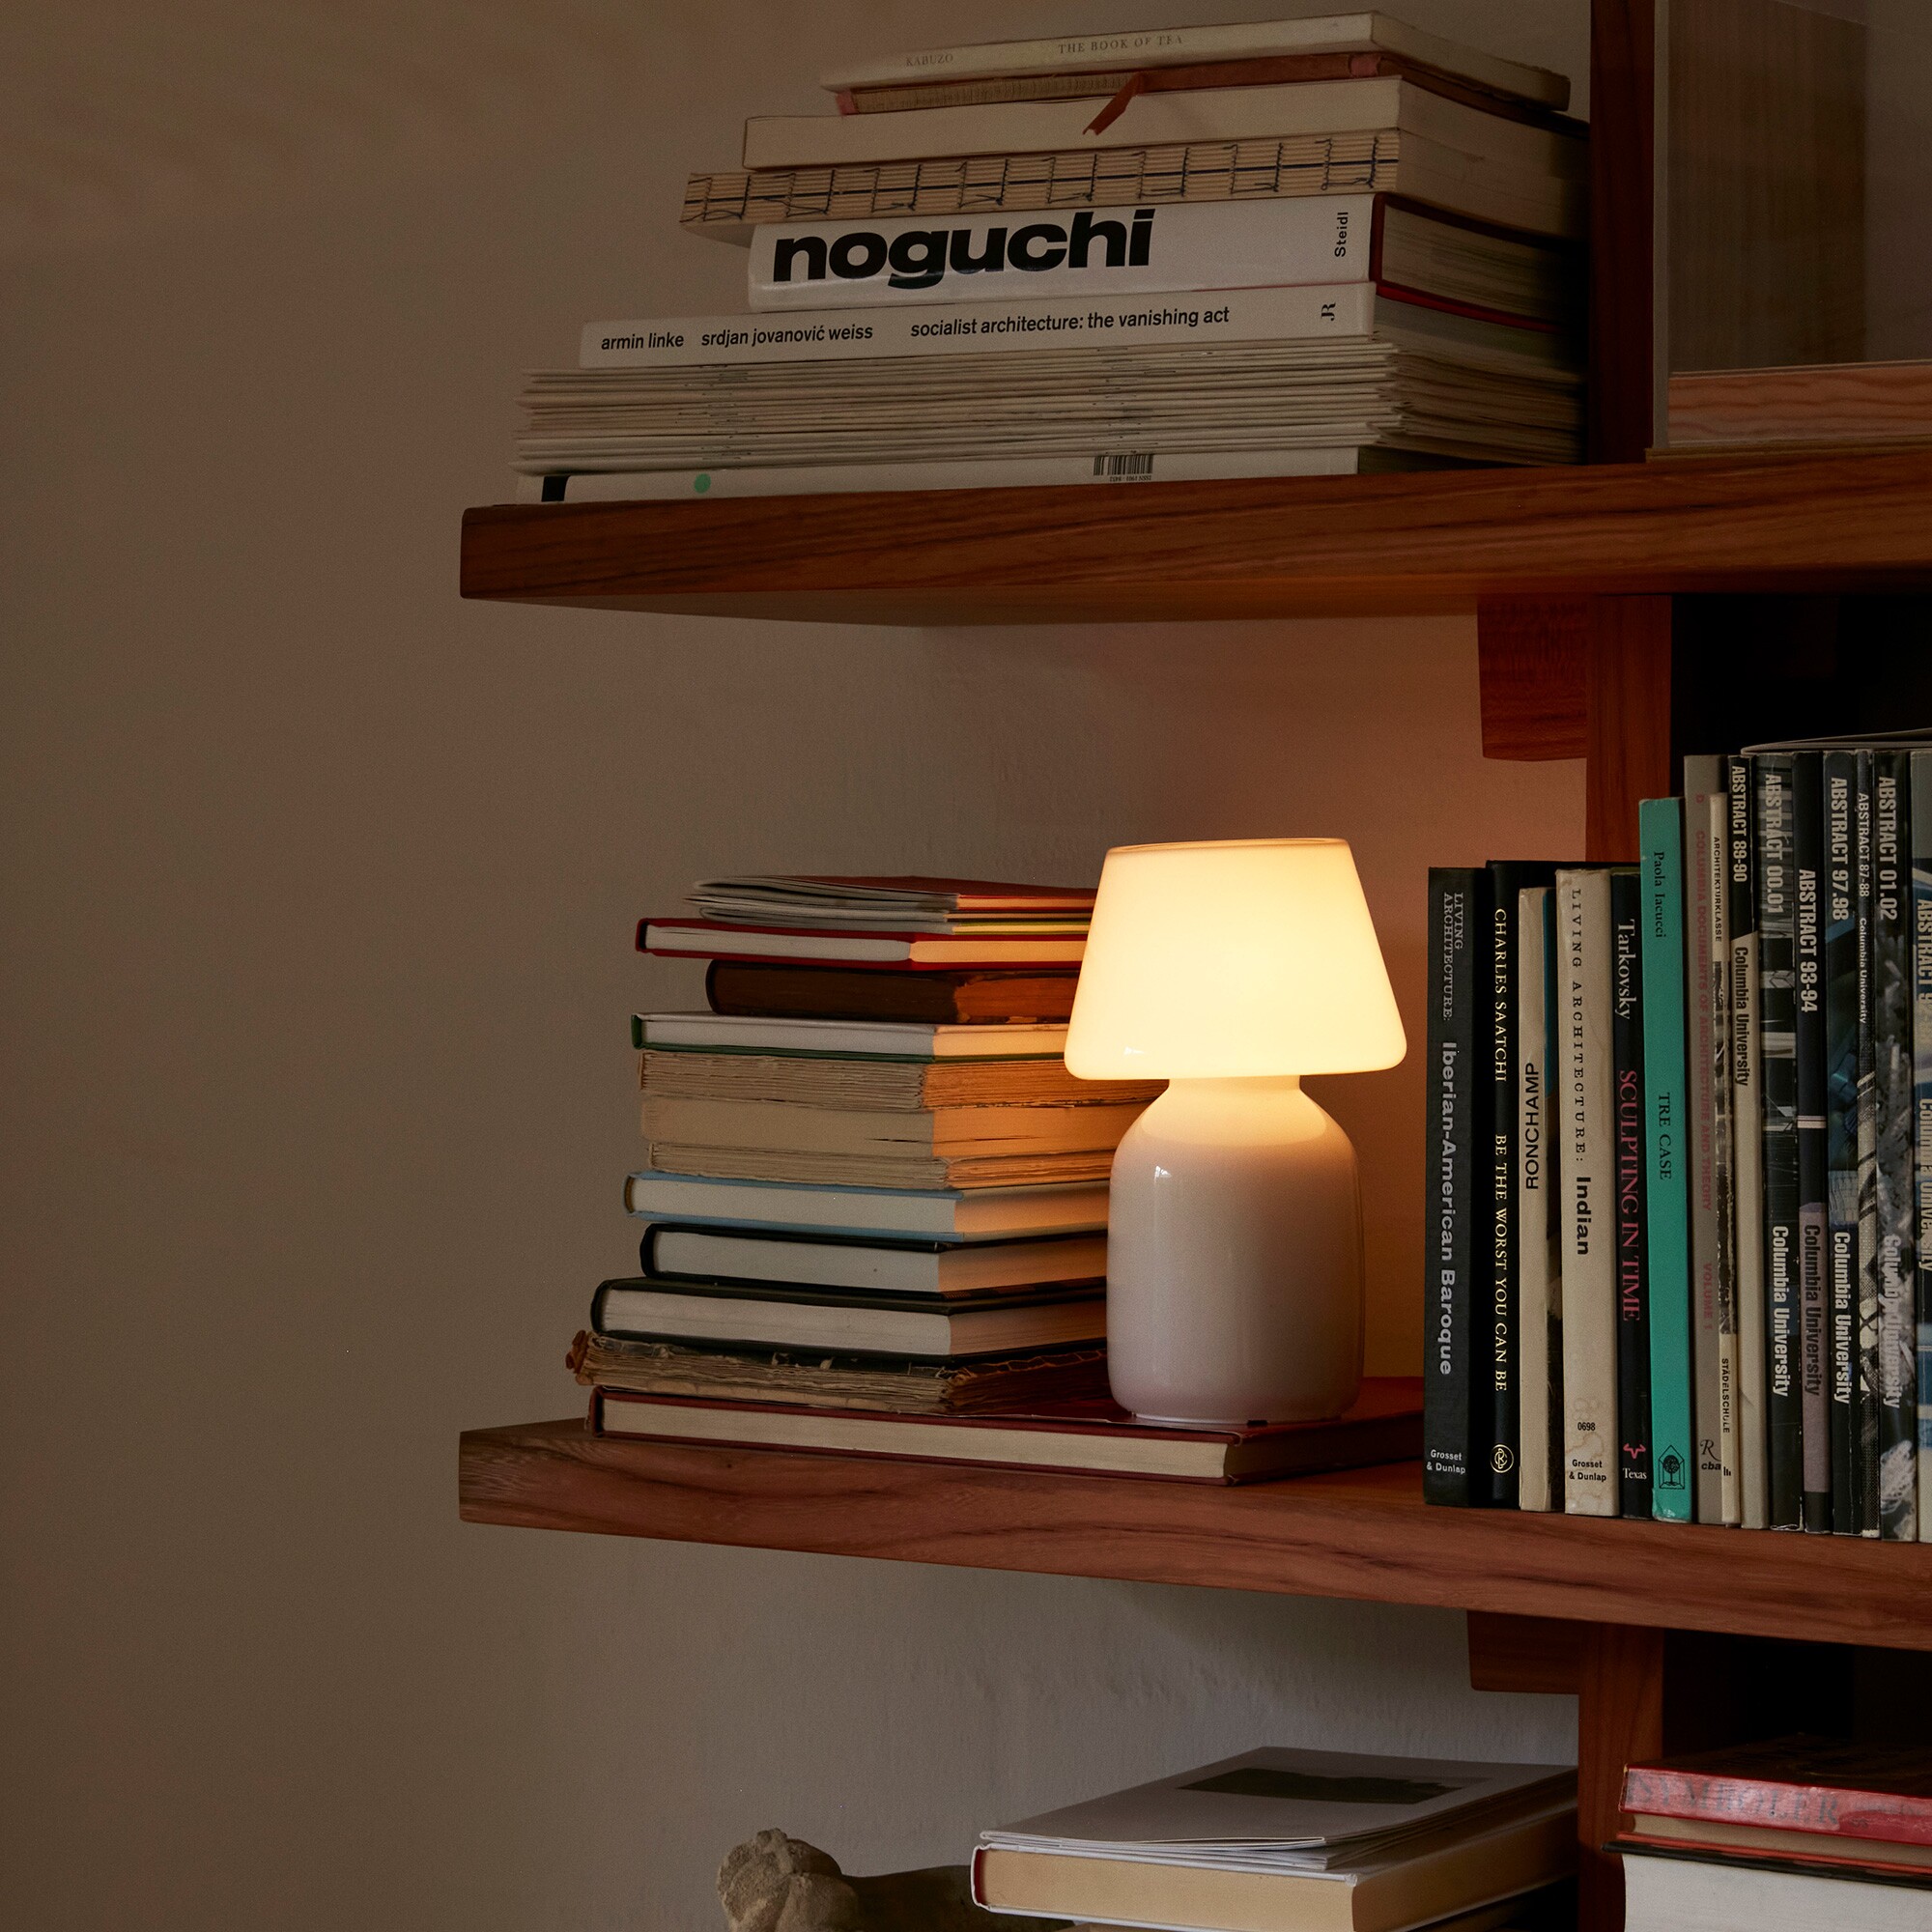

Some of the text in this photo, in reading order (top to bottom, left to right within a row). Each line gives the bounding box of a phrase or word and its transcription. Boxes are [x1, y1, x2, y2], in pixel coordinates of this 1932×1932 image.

[1058, 35, 1182, 54] THE BOOK OF TEA
[773, 209, 1155, 289] noguchi
[1334, 212, 1349, 257] Steidl
[601, 324, 873, 350] armin linke srdjan jovanović weiss
[911, 306, 1230, 336] socialist architecture: the vanishing act
[1732, 765, 1747, 883] ABSTRACT 89-90
[1765, 774, 1784, 913] ABSTRACT 00.01
[1831, 777, 1850, 921] ABSTRACT 97.98
[1858, 792, 1870, 897] ABSTRACT 87-88
[1878, 777, 1898, 921] ABSTRACT 01.02
[1454, 892, 1463, 950] LIVING
[1654, 851, 1667, 938] Paola Iacucci
[1714, 837, 1722, 942] ARCHITEKTURKLASSE
[1799, 869, 1818, 1012] ABSTRACT 93-94
[1918, 898, 1932, 984] ABSTRACT
[1443, 892, 1454, 1021] ARCHITECTURE:
[1494, 908, 1507, 1082] CHARLES SAATCHI
[1615, 919, 1636, 1020] Tarkovsky
[1859, 918, 1868, 1024] Columbia University
[1572, 889, 1585, 1161] LIVING ARCHITECTURE:
[1696, 831, 1712, 1210] COLUMBIA DOCUMENTS OF ARCHITECTURE AND THEORY
[1734, 947, 1750, 1086] Columbia University
[1525, 1063, 1539, 1189] RONCHAMP
[1659, 1093, 1672, 1179] TRE CASE
[1437, 1041, 1457, 1375] Iberian-American Baroque
[1577, 1177, 1592, 1255] Indian
[1619, 1070, 1640, 1321] SCULPTING IN TIME
[1495, 1134, 1508, 1392] BE THE WORST YOU CAN BE
[1702, 1264, 1713, 1319] VOLUME
[1772, 1226, 1791, 1397] Columbia University
[1804, 1225, 1822, 1396] Columbia University
[1834, 1232, 1852, 1405] Columbia University
[1577, 1422, 1596, 1432] 0698
[1721, 1358, 1730, 1433] STÄDELSCHULE
[1426, 1462, 1466, 1475] & Dunlap
[1430, 1449, 1463, 1462] Grosset
[1569, 1471, 1606, 1483] & Dunlap
[1572, 1459, 1603, 1468] Grosset
[1623, 1467, 1647, 1480] Texas
[1701, 1462, 1721, 1470] cba
